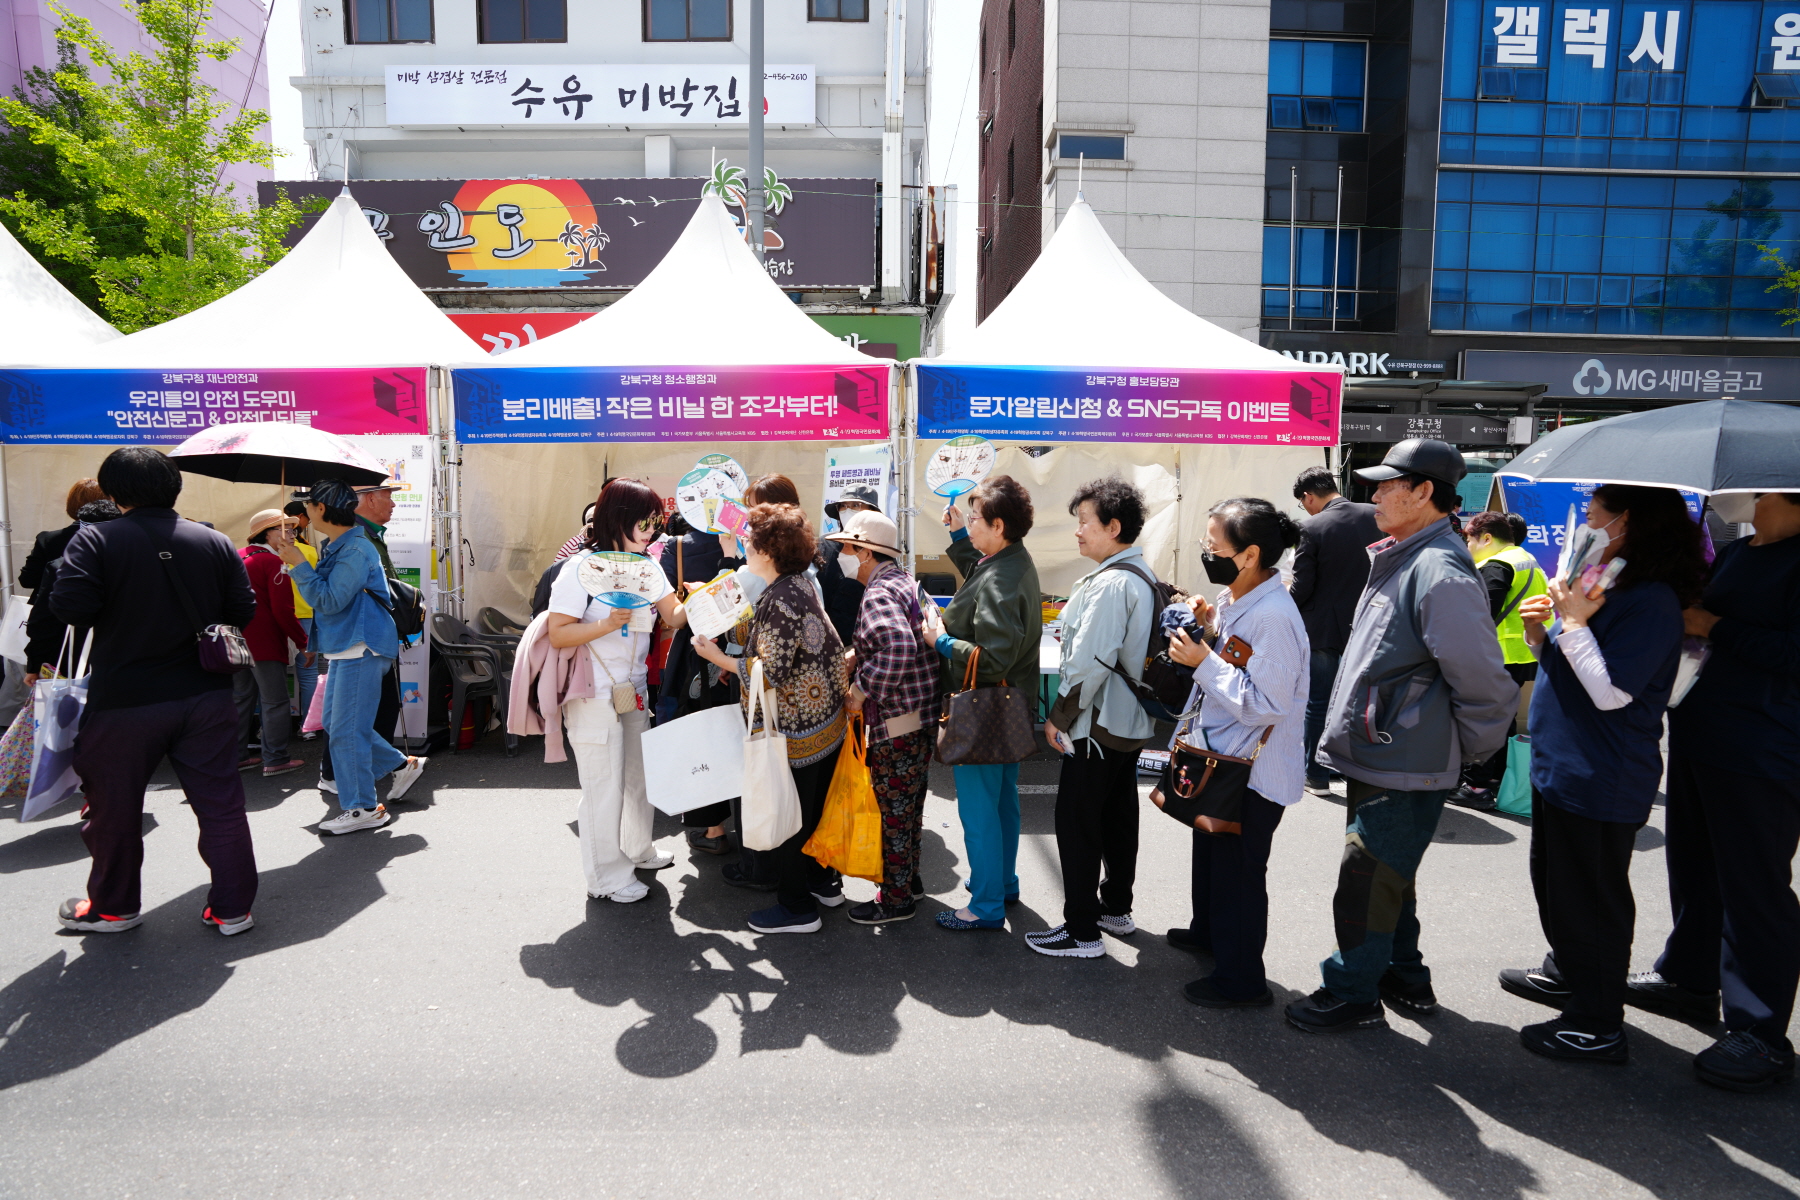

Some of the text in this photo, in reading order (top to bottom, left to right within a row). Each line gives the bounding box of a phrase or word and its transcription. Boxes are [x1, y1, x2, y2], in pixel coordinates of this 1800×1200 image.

[1493, 7, 1680, 70] 갤럭시
[397, 70, 507, 84] 미박 삼겹살 전문점
[763, 73, 808, 81] 2-456-2610
[511, 74, 741, 120] 수유 미박집
[162, 373, 259, 384] 강북구청 재난안전과
[620, 373, 717, 386] 강북구청 청소행정과
[1086, 375, 1180, 388] 강북구청 홍보담당관
[129, 390, 297, 408] 우리들의 안전 도우미
[502, 395, 838, 421] 분리배출! 작은 비닐 한 조각부터!
[969, 396, 1290, 423] 문자알림신청 & SNS구독 이벤트
[208, 411, 221, 426] &
[1408, 418, 1442, 429] 강북구청
[1136, 758, 1163, 770] 이벤트
